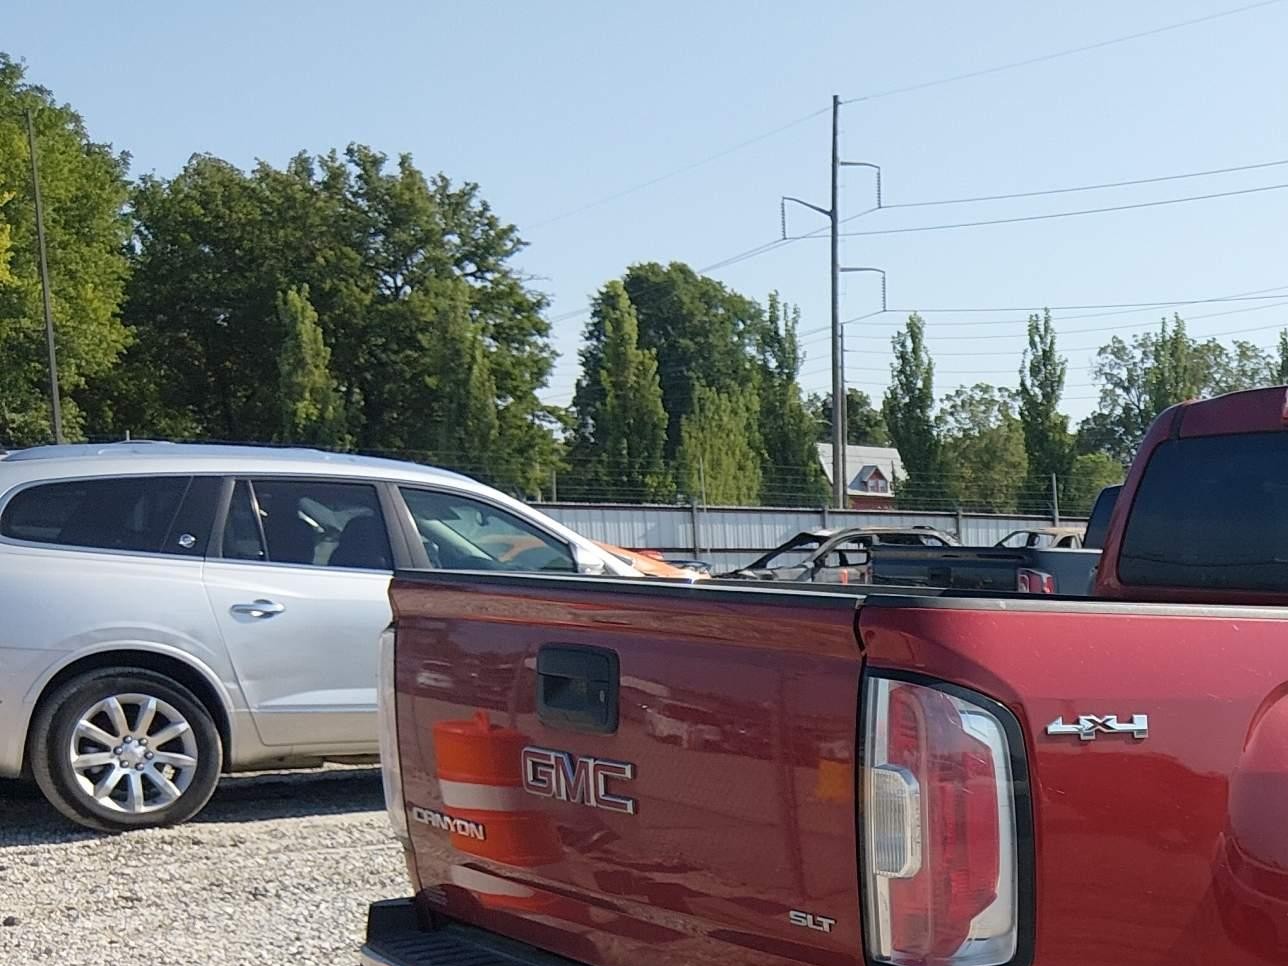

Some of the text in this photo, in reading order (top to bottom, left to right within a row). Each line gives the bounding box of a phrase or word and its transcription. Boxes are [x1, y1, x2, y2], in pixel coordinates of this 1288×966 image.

[521, 746, 635, 816] GMC
[411, 805, 485, 841] CANYON
[789, 909, 837, 933] SLT
